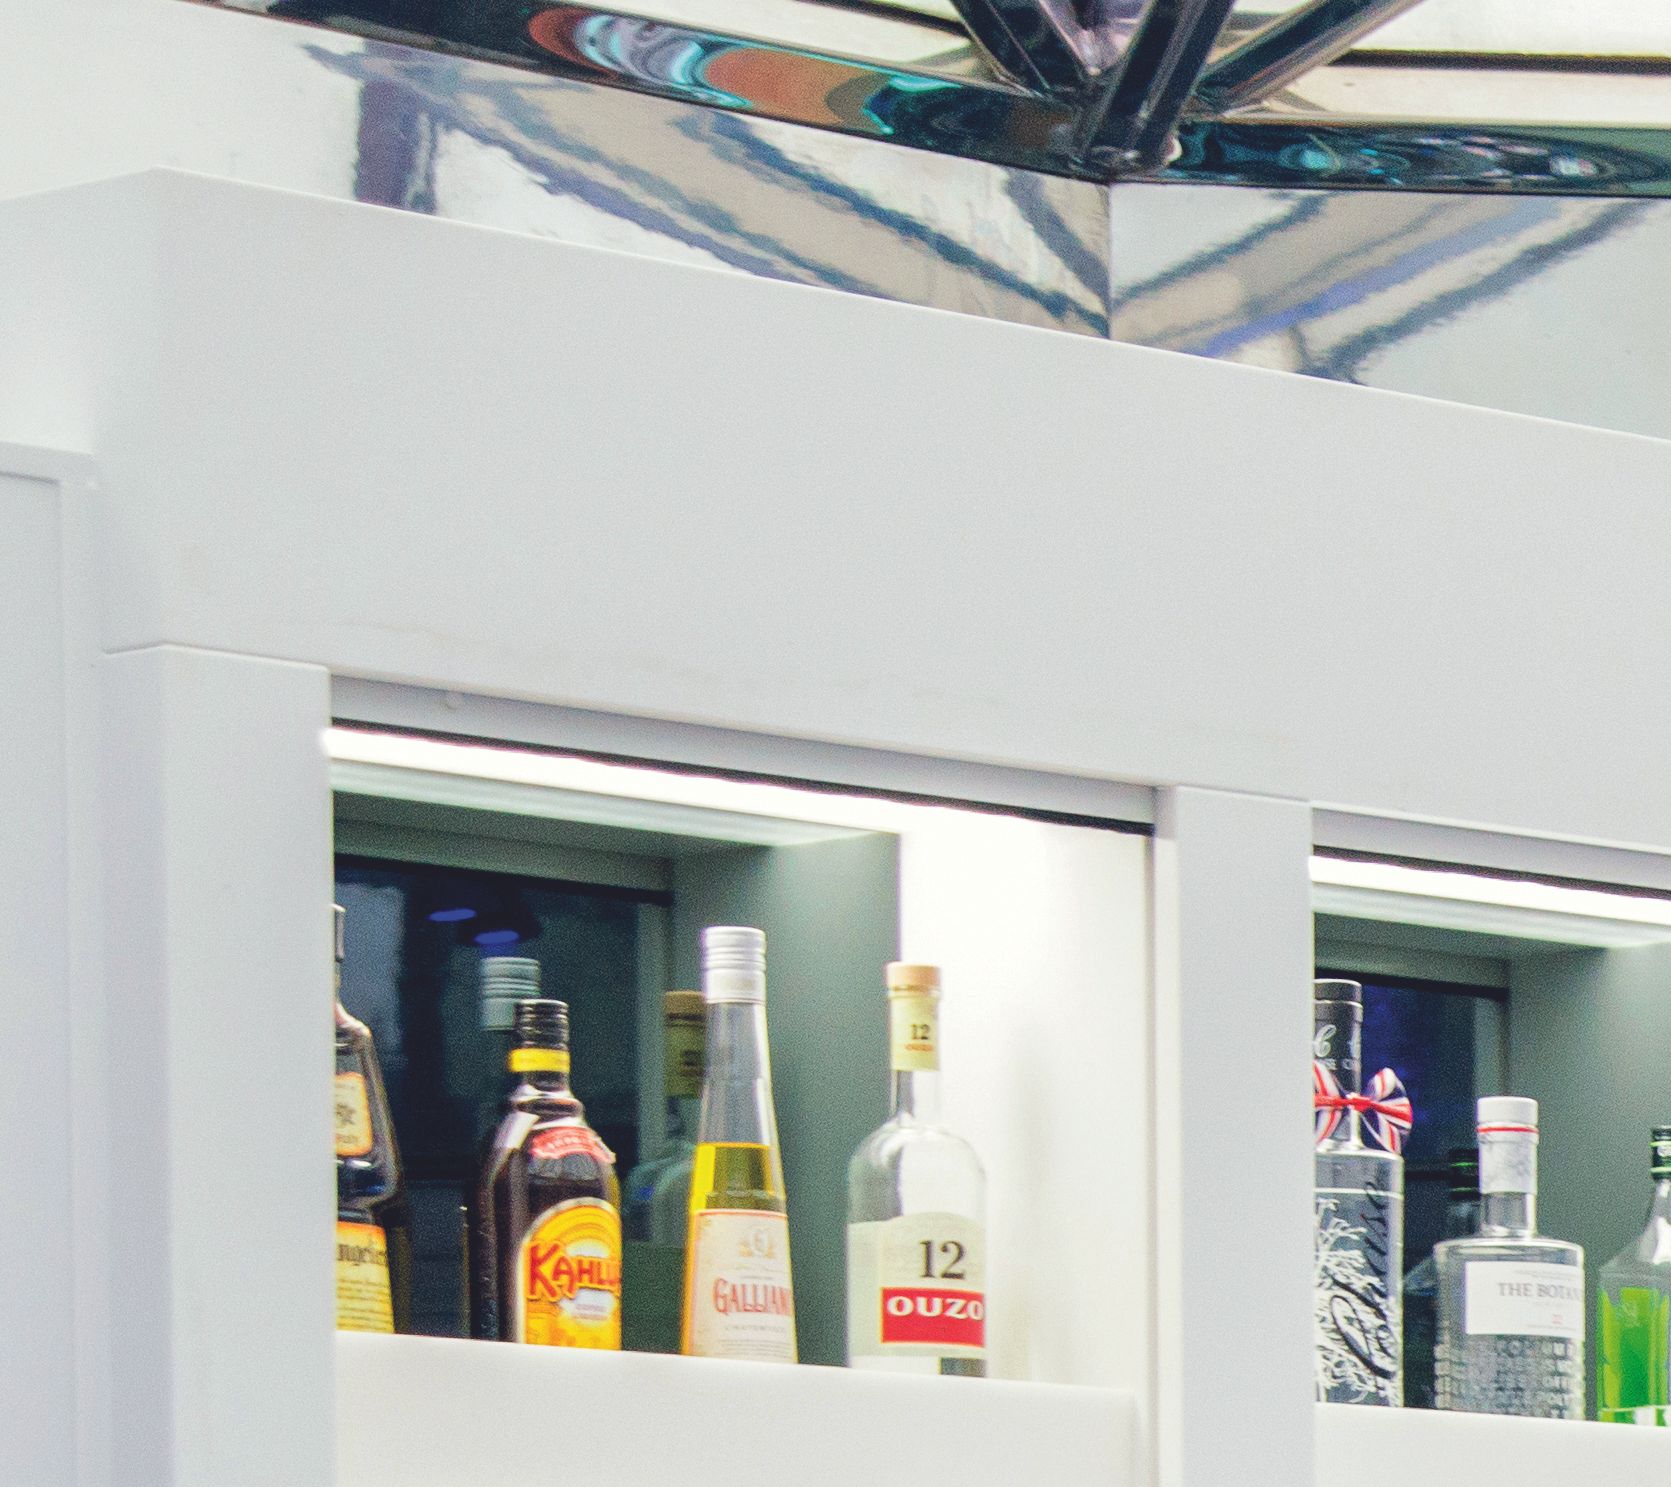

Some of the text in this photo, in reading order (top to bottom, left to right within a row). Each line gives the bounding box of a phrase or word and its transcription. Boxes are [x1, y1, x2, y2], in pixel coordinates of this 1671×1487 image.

[911, 1024, 931, 1040] 12
[919, 1240, 965, 1279] 12
[713, 1278, 792, 1317] GALLIAN
[1497, 1283, 1533, 1296] THE
[887, 1296, 984, 1321] OUZO
